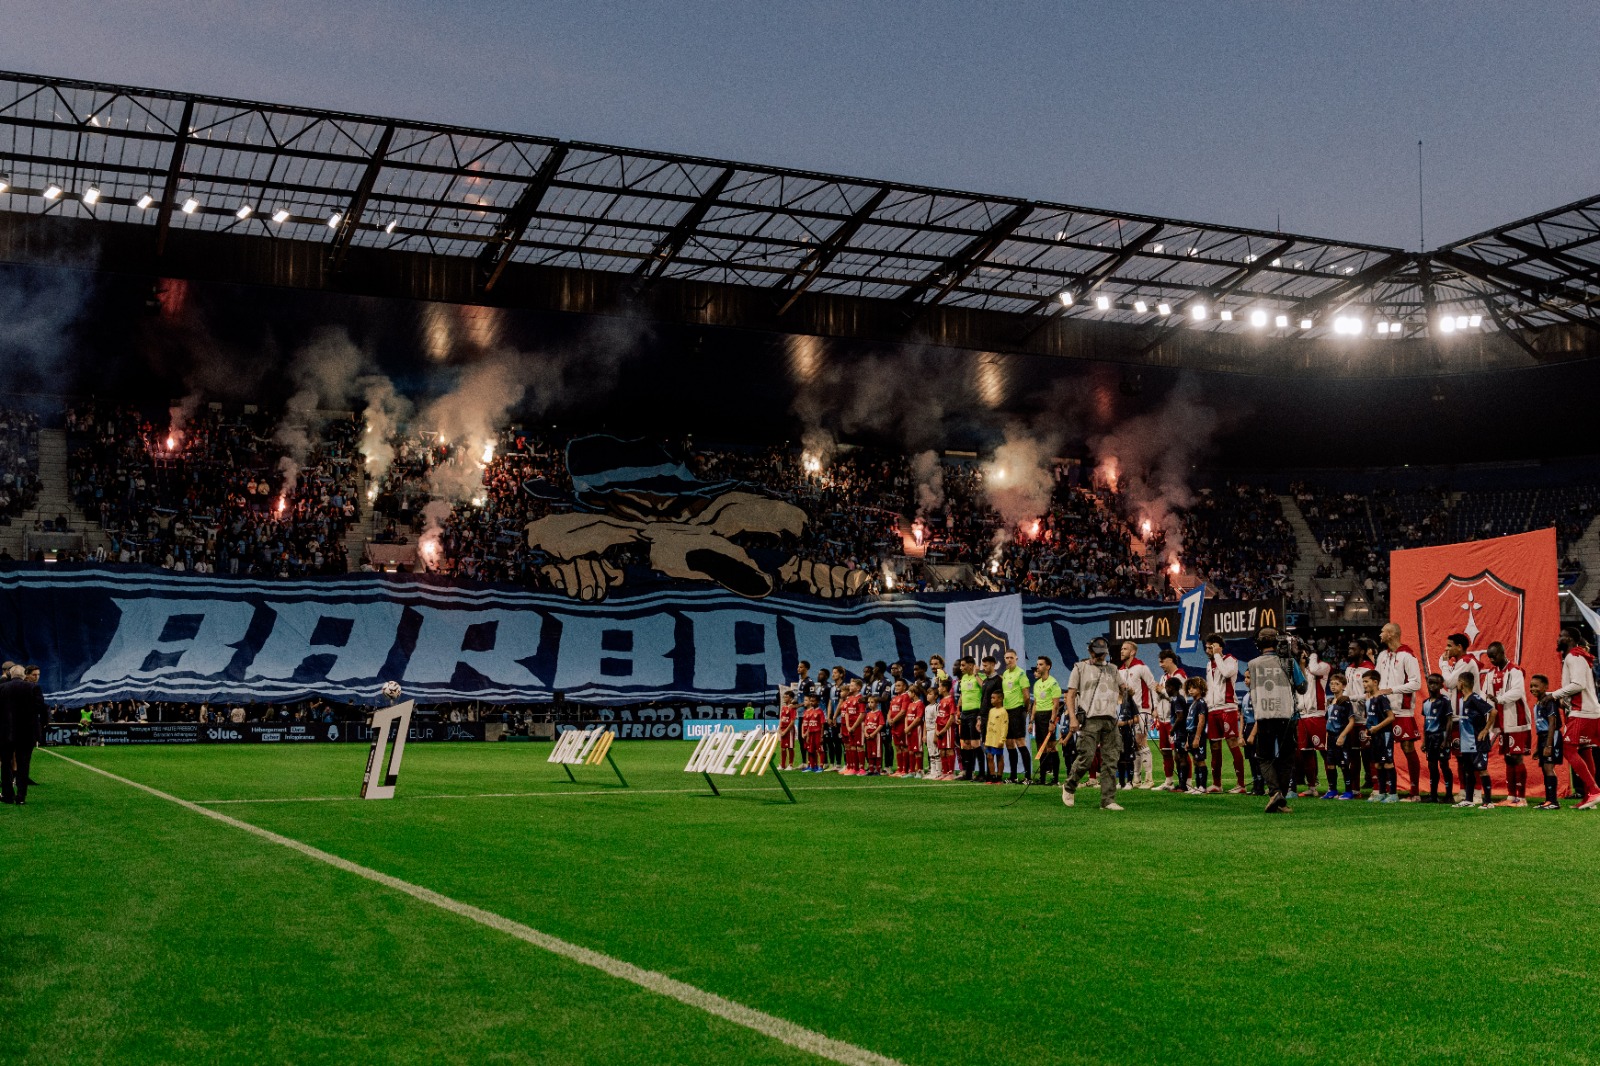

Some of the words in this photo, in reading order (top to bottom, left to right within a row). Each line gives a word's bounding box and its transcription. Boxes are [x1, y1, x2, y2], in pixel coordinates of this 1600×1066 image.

[1115, 619, 1143, 640] LIGUE
[1213, 611, 1246, 634] LIGUE
[1256, 667, 1280, 677] LFP
[687, 725, 713, 737] LIGUE
